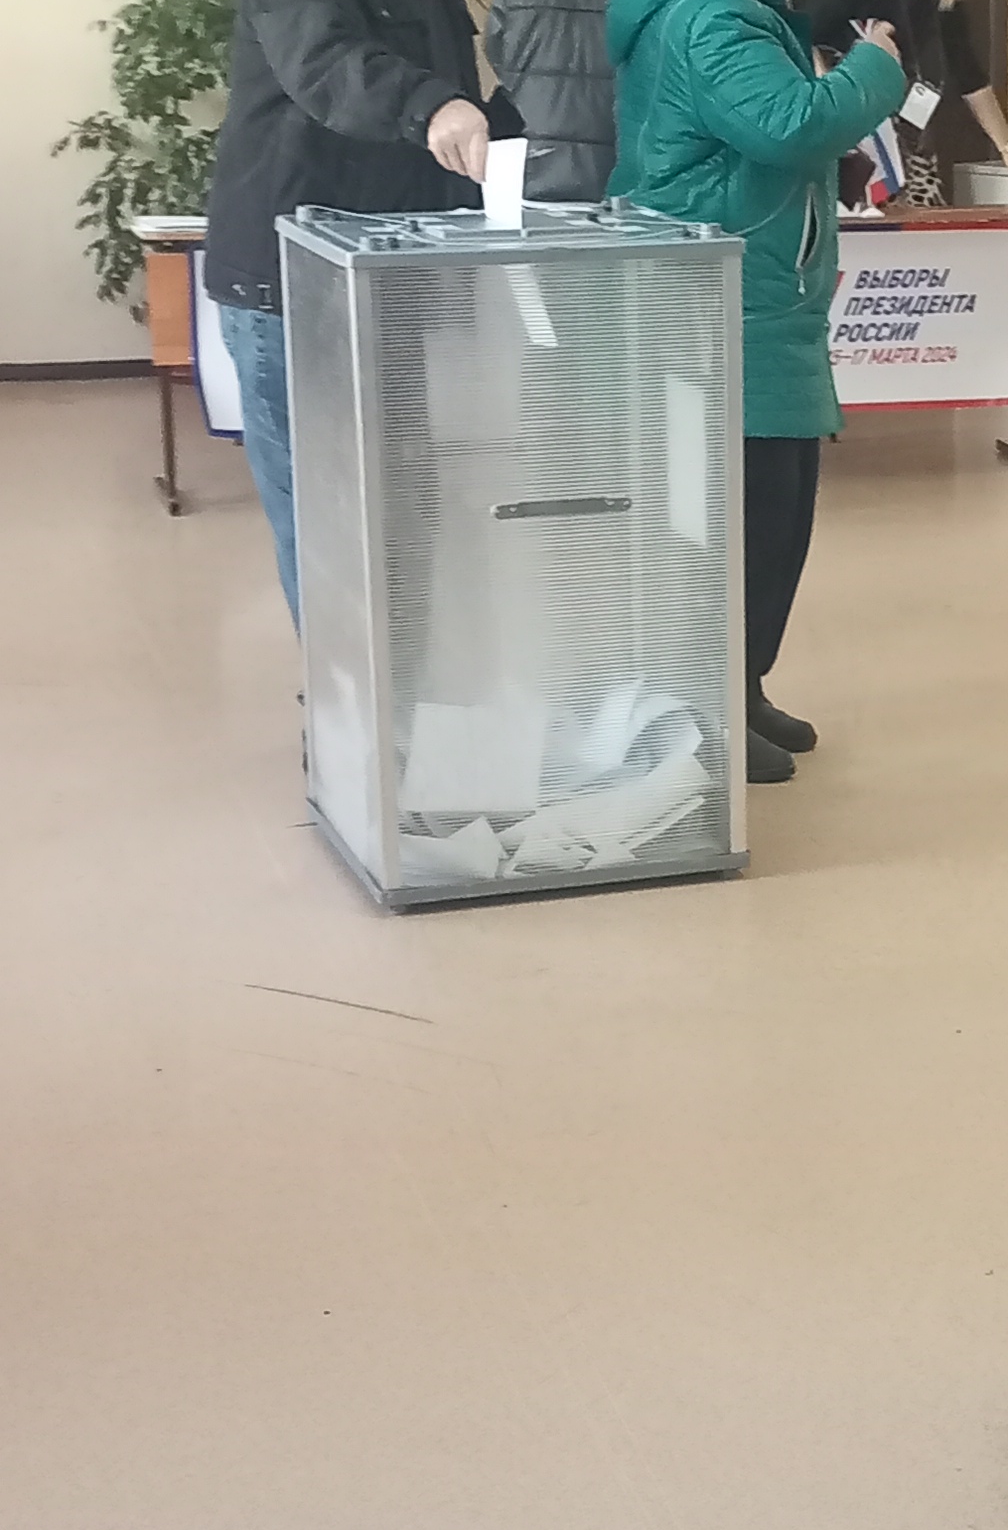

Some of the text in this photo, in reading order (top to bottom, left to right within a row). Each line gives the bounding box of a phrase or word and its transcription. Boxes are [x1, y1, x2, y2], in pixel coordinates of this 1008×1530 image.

[853, 268, 951, 289] ВЫБОРЫ
[843, 294, 977, 317] ПРЕЗИДЕНТА
[832, 322, 920, 343] РОССИИ
[867, 347, 920, 365] МАРТА
[921, 346, 958, 364] 2024
